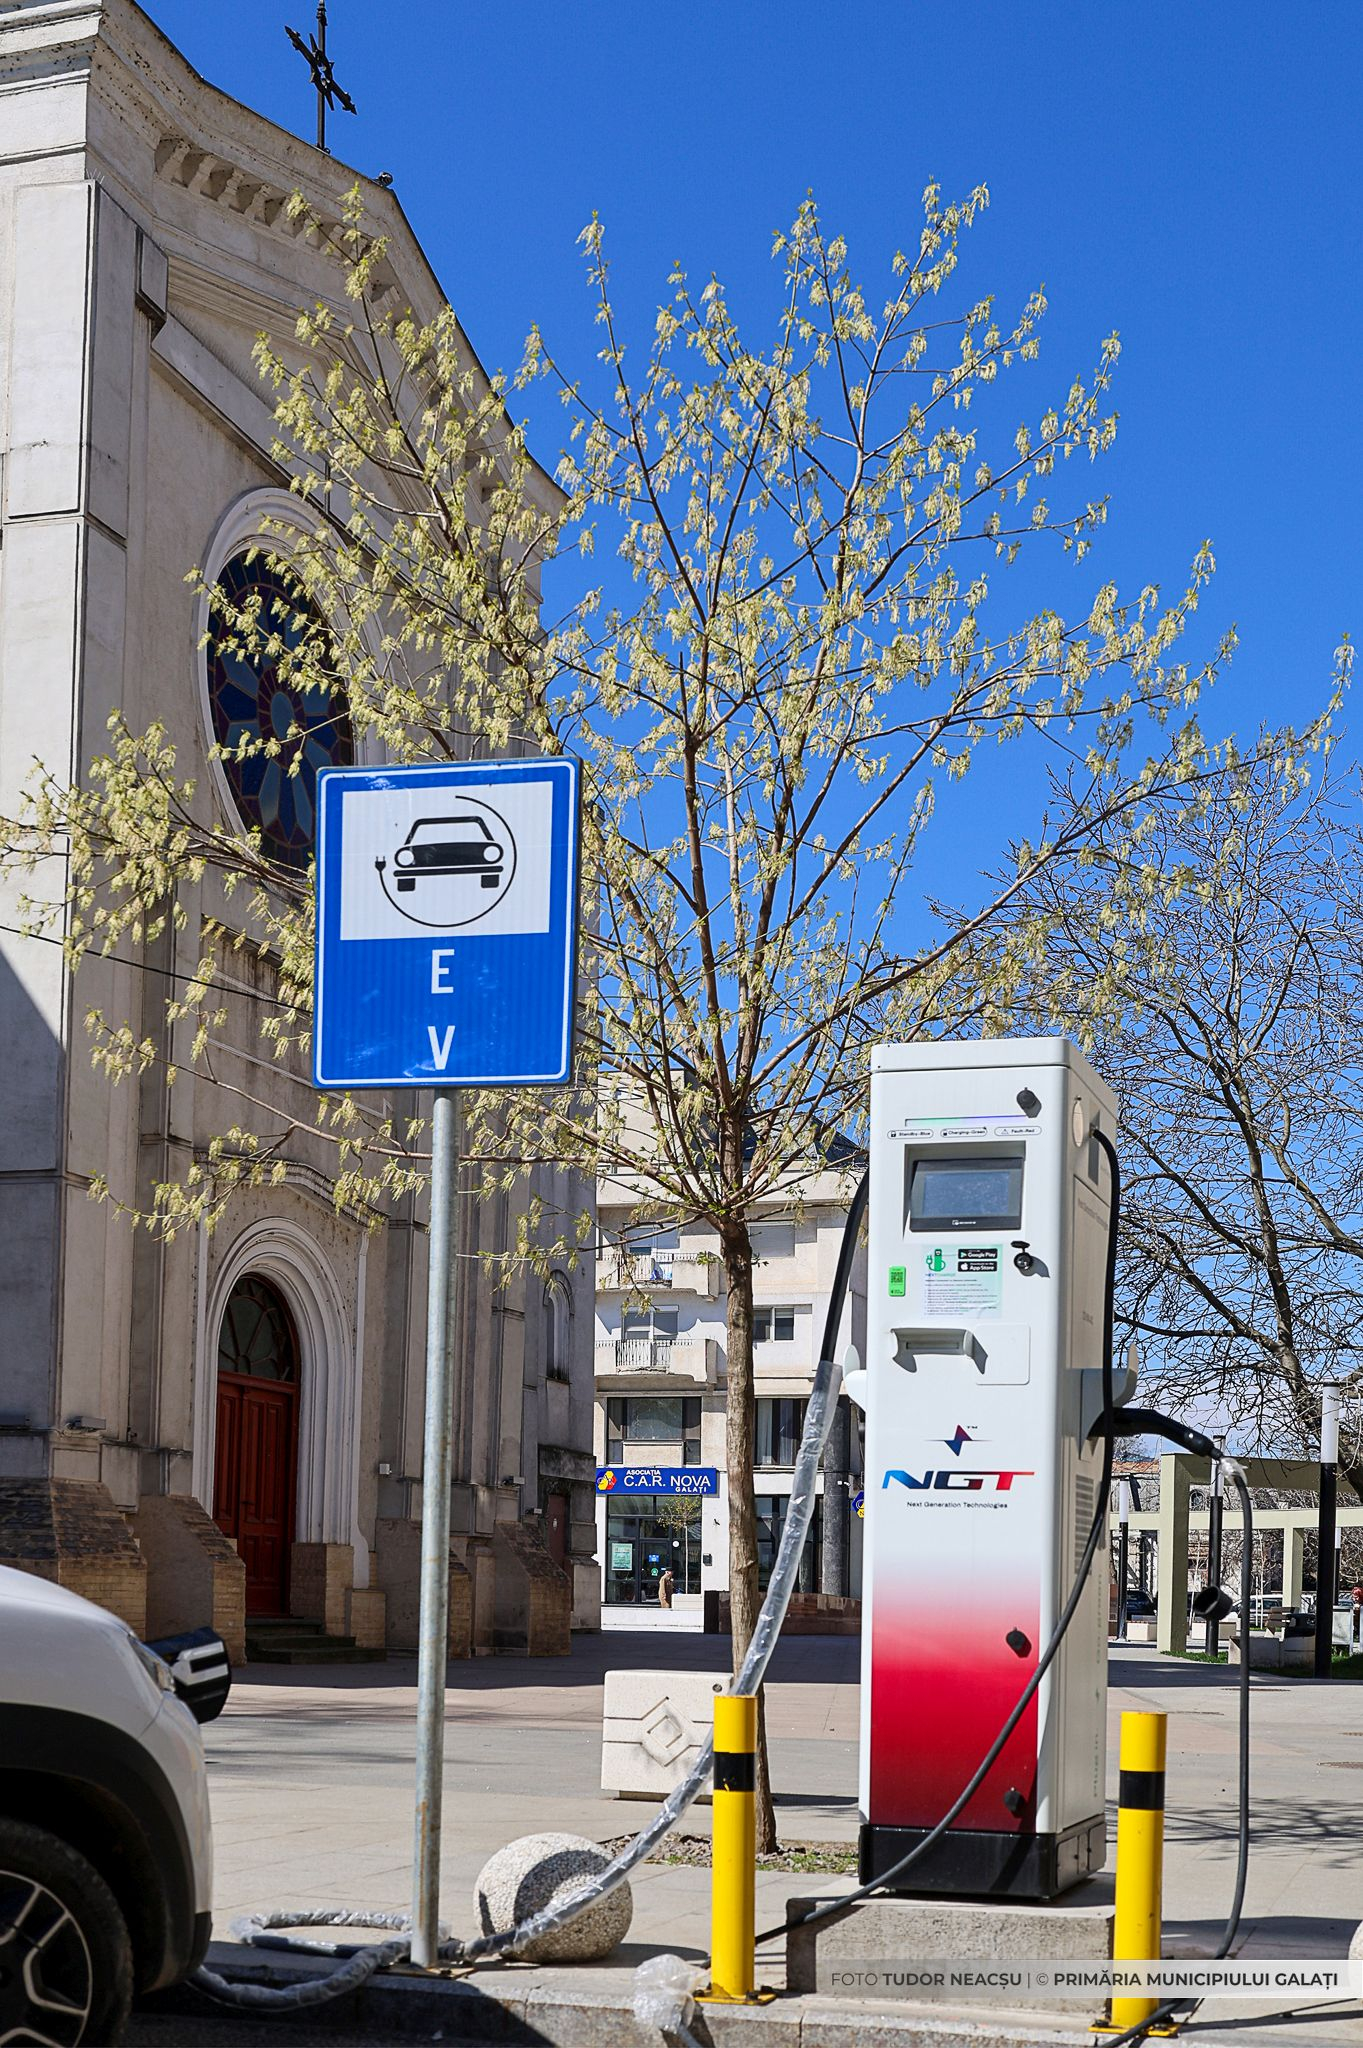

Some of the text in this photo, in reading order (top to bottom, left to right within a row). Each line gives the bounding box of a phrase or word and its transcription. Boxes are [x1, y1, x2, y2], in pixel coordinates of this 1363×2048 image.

[431, 949, 455, 994] E
[427, 1025, 455, 1071] V
[623, 1475, 711, 1487] C.A.R. NOVA
[882, 1469, 1035, 1491] NGT
[675, 1486, 707, 1494] GALAȚI
[963, 1501, 1008, 1509] Technologies
